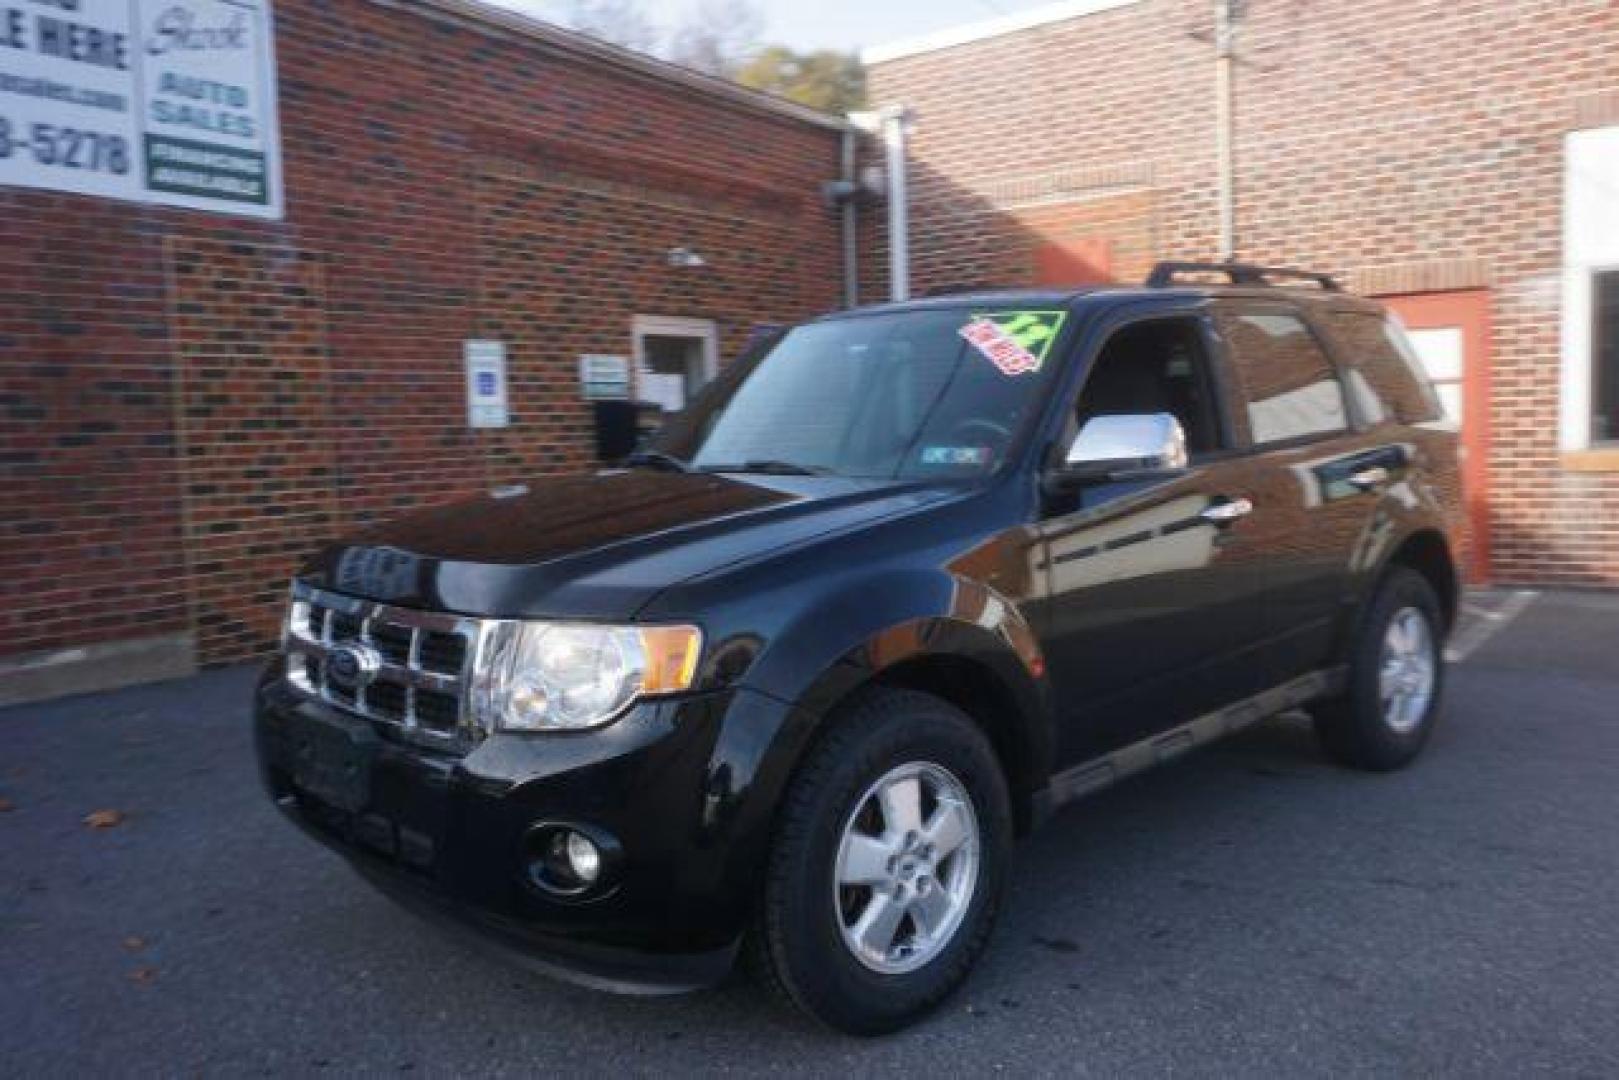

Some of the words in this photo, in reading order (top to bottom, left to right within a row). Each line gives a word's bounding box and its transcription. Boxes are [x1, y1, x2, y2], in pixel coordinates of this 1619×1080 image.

[36, 15, 128, 71] HERE
[159, 71, 248, 108] AUTO
[151, 100, 256, 137] SALES
